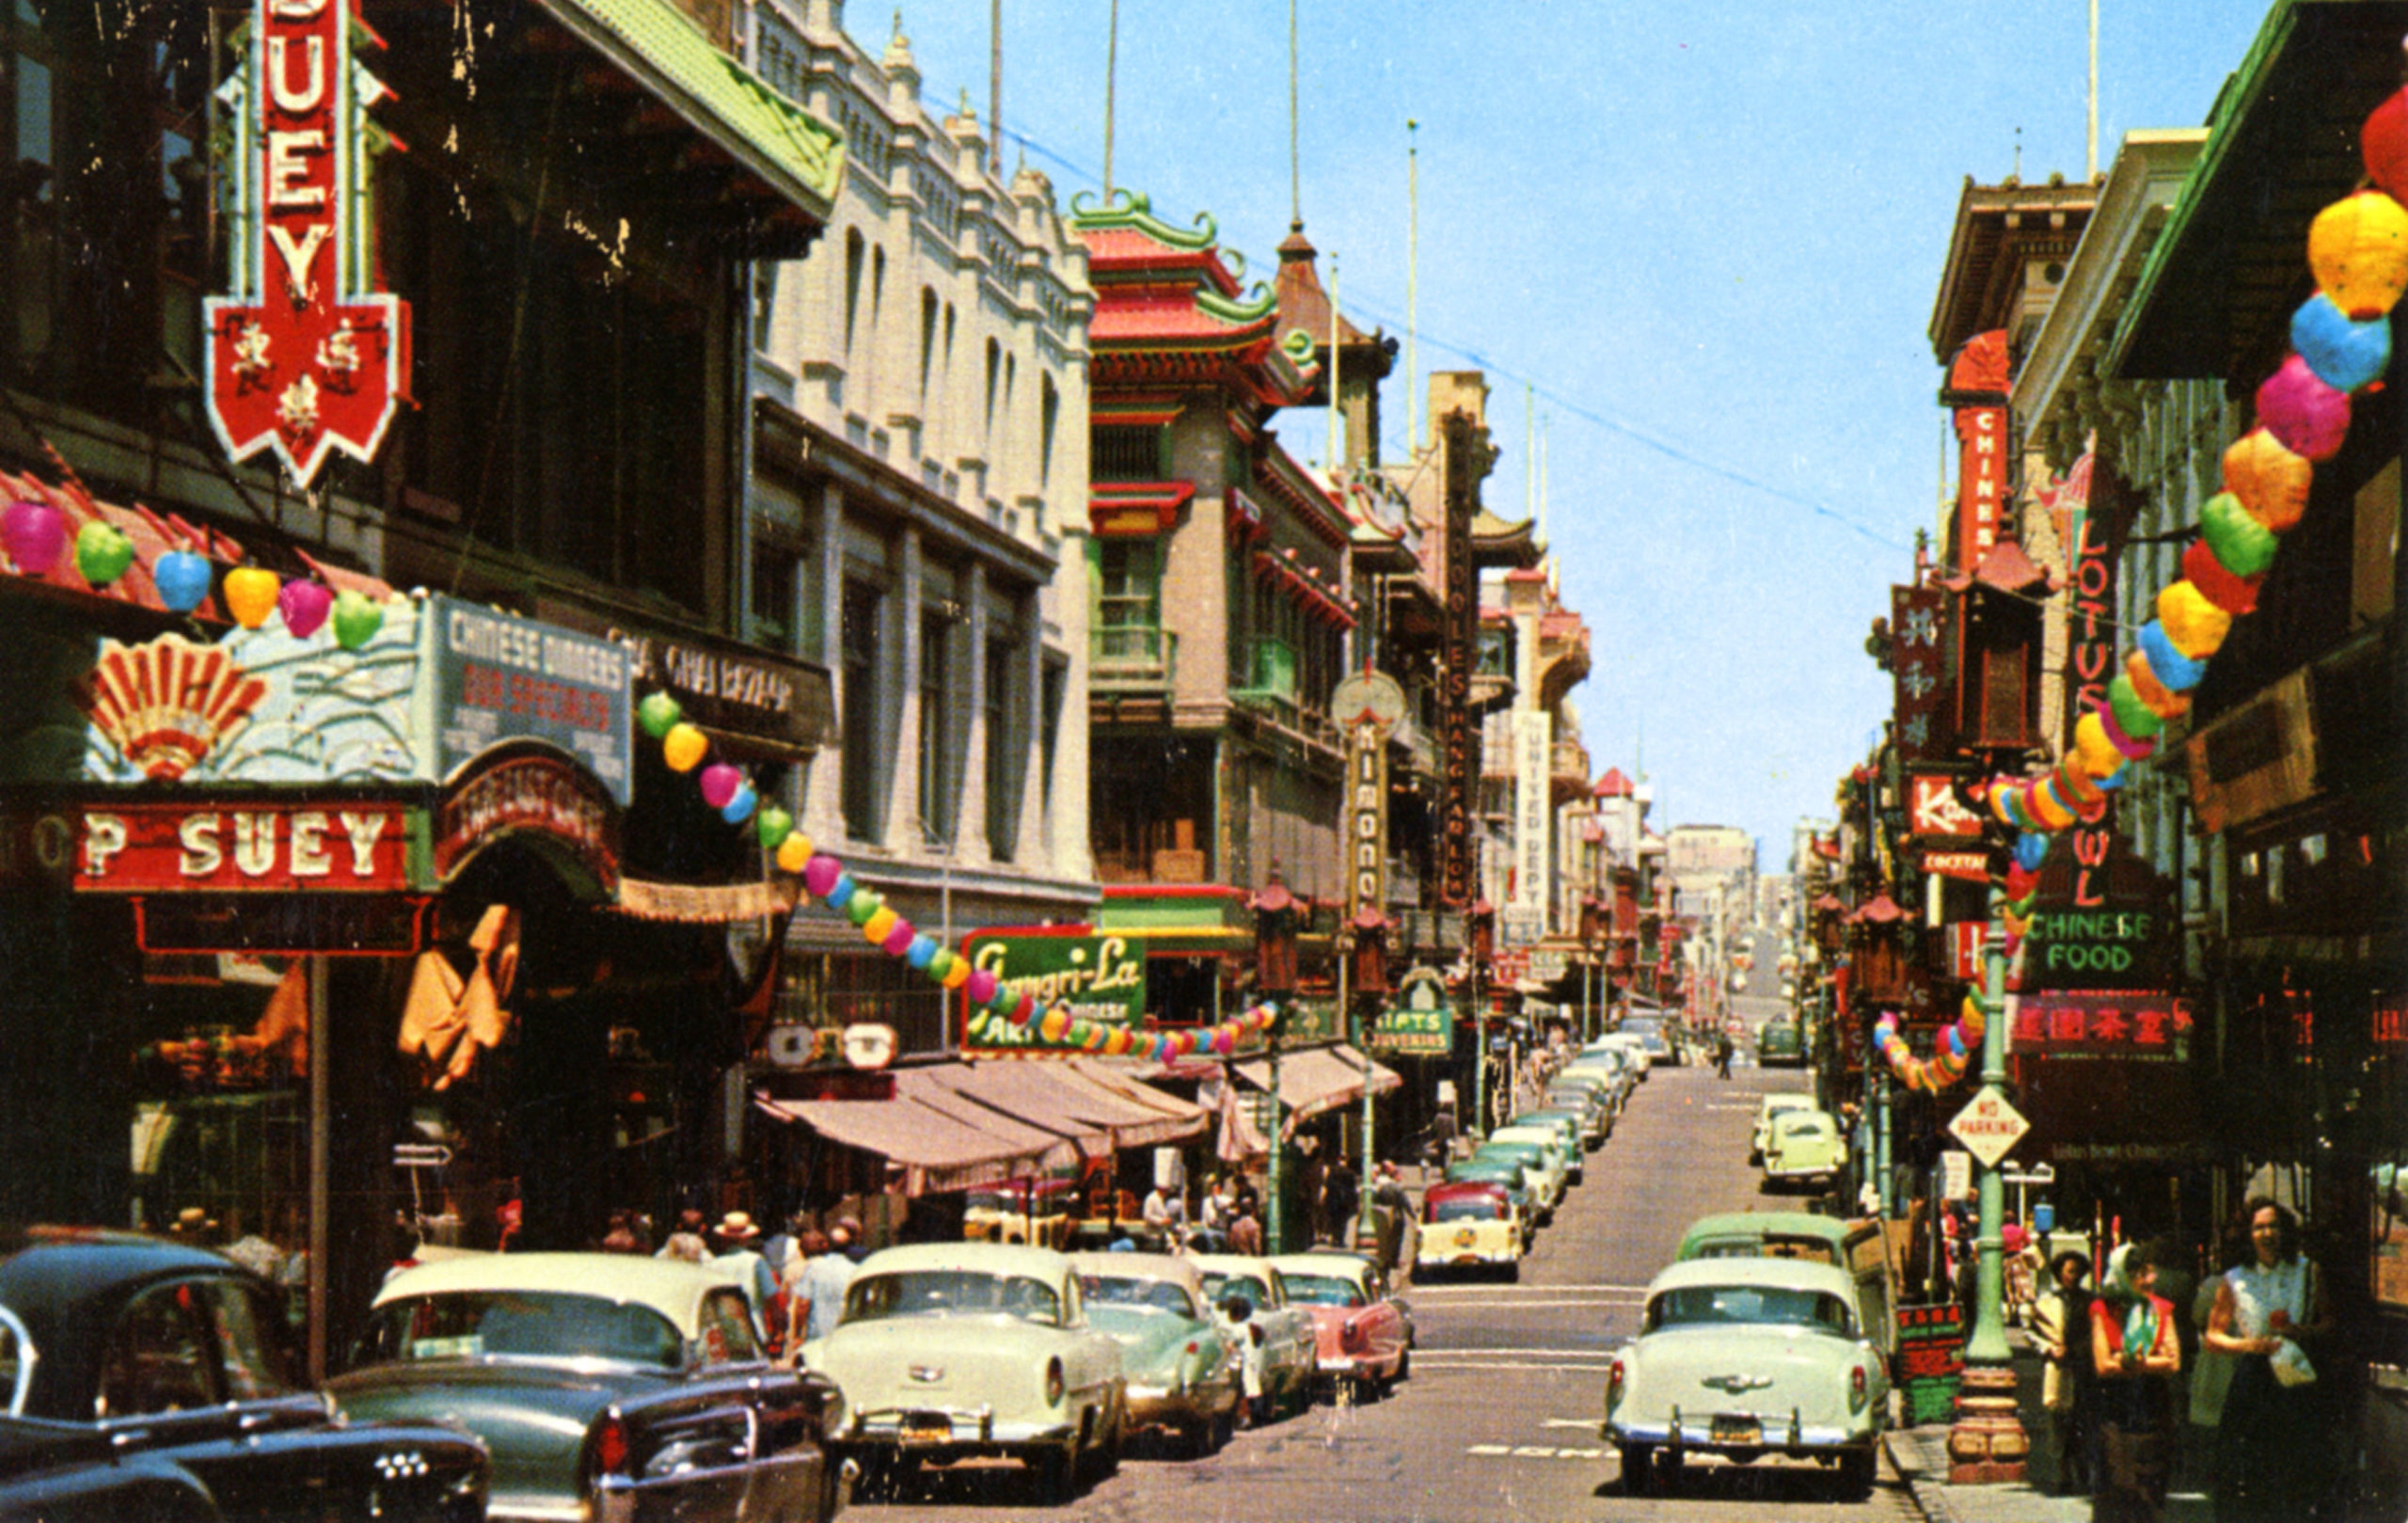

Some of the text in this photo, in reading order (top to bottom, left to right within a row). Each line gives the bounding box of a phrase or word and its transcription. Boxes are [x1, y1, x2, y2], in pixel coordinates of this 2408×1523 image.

[267, 0, 329, 299] UEY
[1975, 412, 1996, 563] CHINES
[450, 609, 540, 671] CHINESE
[2074, 519, 2108, 715] LOTUS
[177, 811, 388, 877] SUEY
[2028, 912, 2152, 941] CHINESE
[2047, 944, 2132, 972] FOOD
[1957, 1118, 2020, 1136] PARKING
[1977, 1100, 1998, 1117] NO
